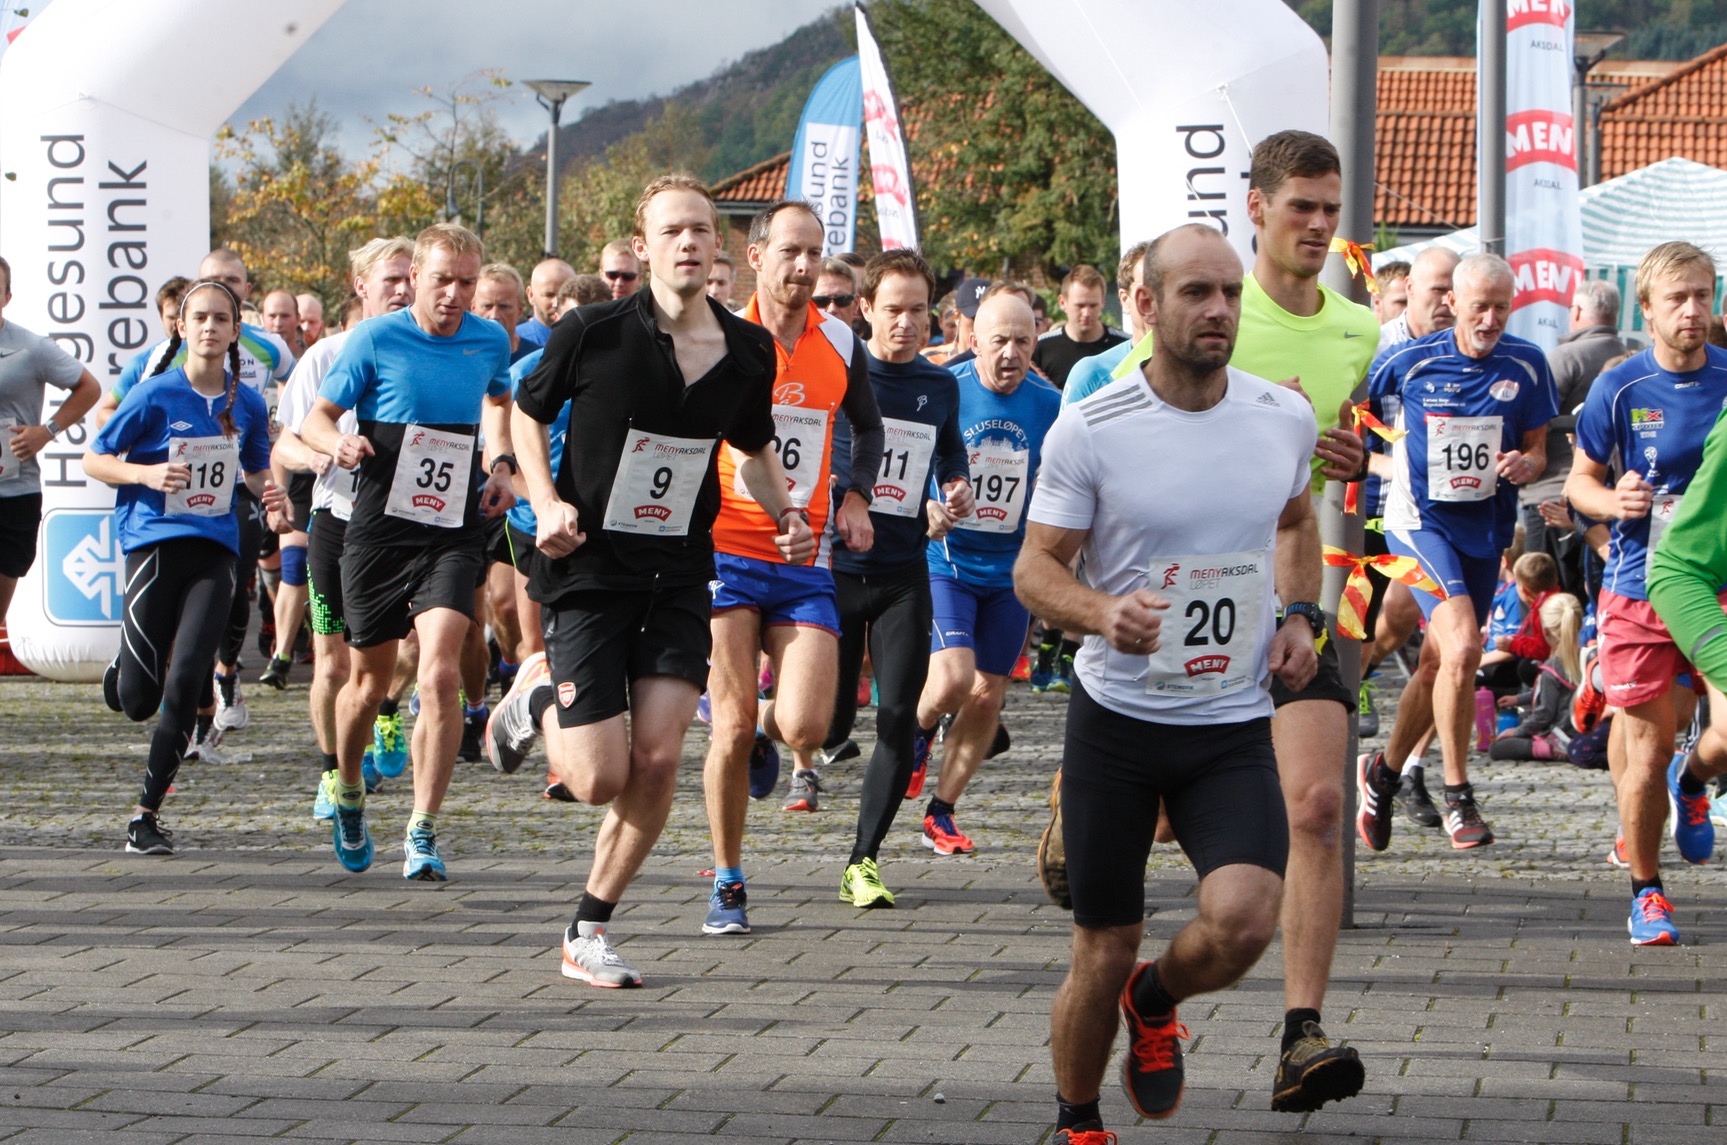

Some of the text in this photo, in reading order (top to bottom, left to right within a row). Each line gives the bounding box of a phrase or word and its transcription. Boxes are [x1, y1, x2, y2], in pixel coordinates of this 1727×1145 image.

[1506, 121, 1576, 160] MEN
[963, 419, 1028, 443] SLUSELØPET
[654, 444, 706, 455] MENYAKSDAL
[1442, 443, 1489, 471] 196
[186, 461, 225, 490] 118
[416, 458, 454, 492] 35
[650, 466, 672, 499] 9
[876, 487, 903, 498] MENY
[972, 474, 1020, 503] 197
[190, 495, 213, 505] MENY
[416, 497, 442, 508] MENY
[638, 508, 668, 517] MENY
[979, 509, 1005, 518] MENY
[1190, 563, 1259, 580] MENYAKSDAL
[1184, 597, 1236, 646] 20
[1190, 658, 1227, 673] MENY
